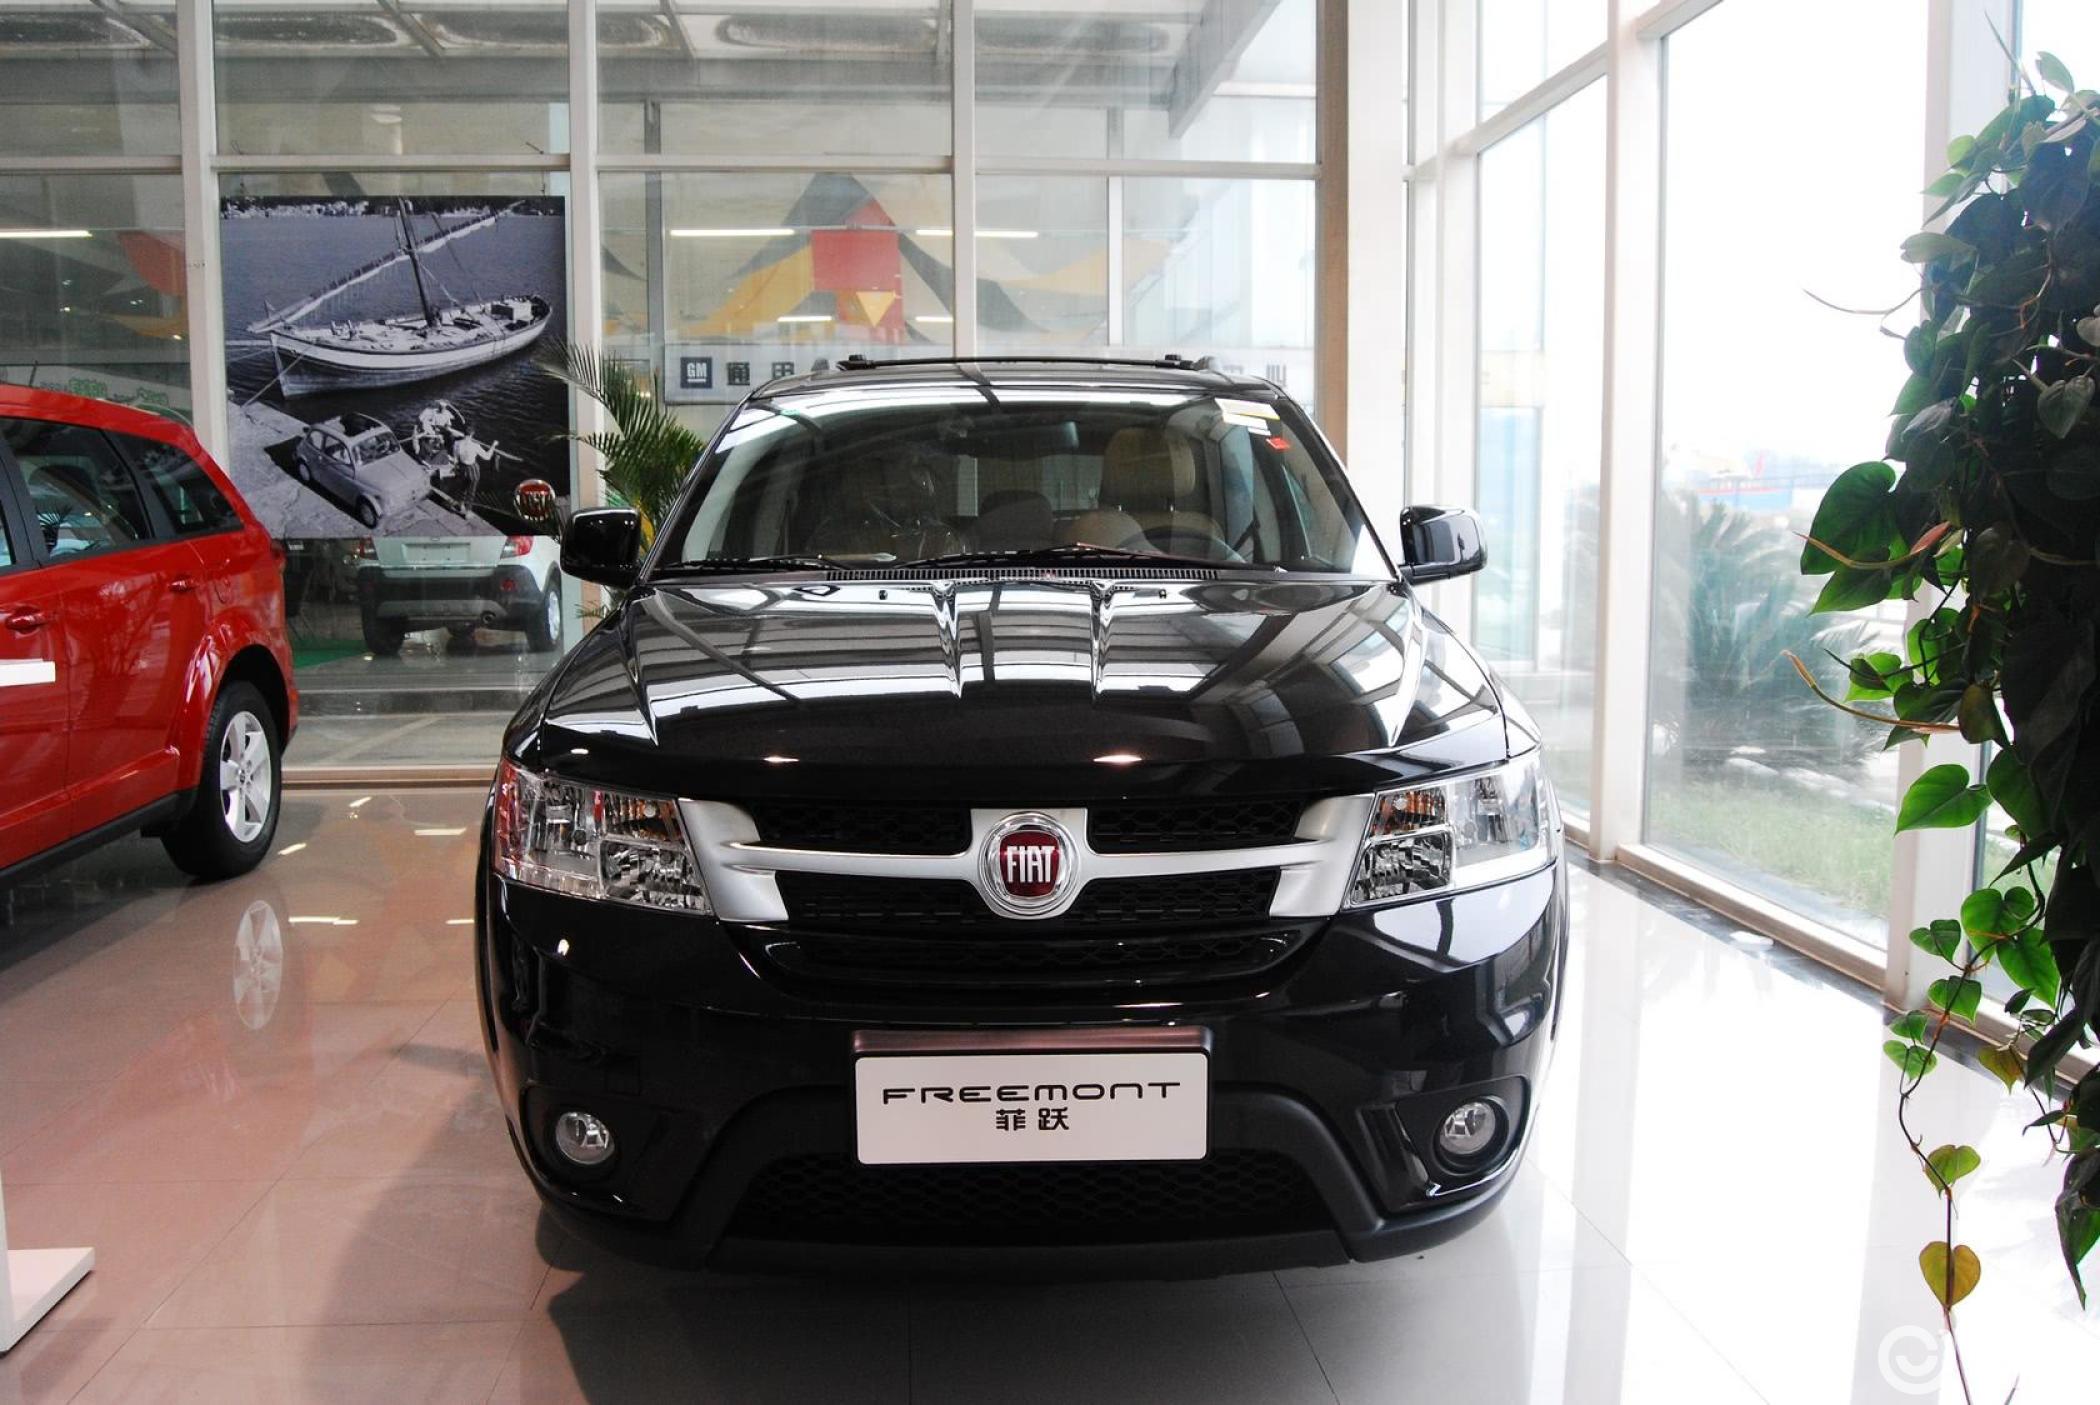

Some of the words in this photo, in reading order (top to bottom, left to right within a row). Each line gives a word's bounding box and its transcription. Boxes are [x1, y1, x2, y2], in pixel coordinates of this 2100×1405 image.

[686, 361, 708, 378] GM
[1006, 845, 1056, 883] FIAT
[882, 1082, 1181, 1105] FREEMONT
[995, 1106, 1070, 1131] 菲跃
